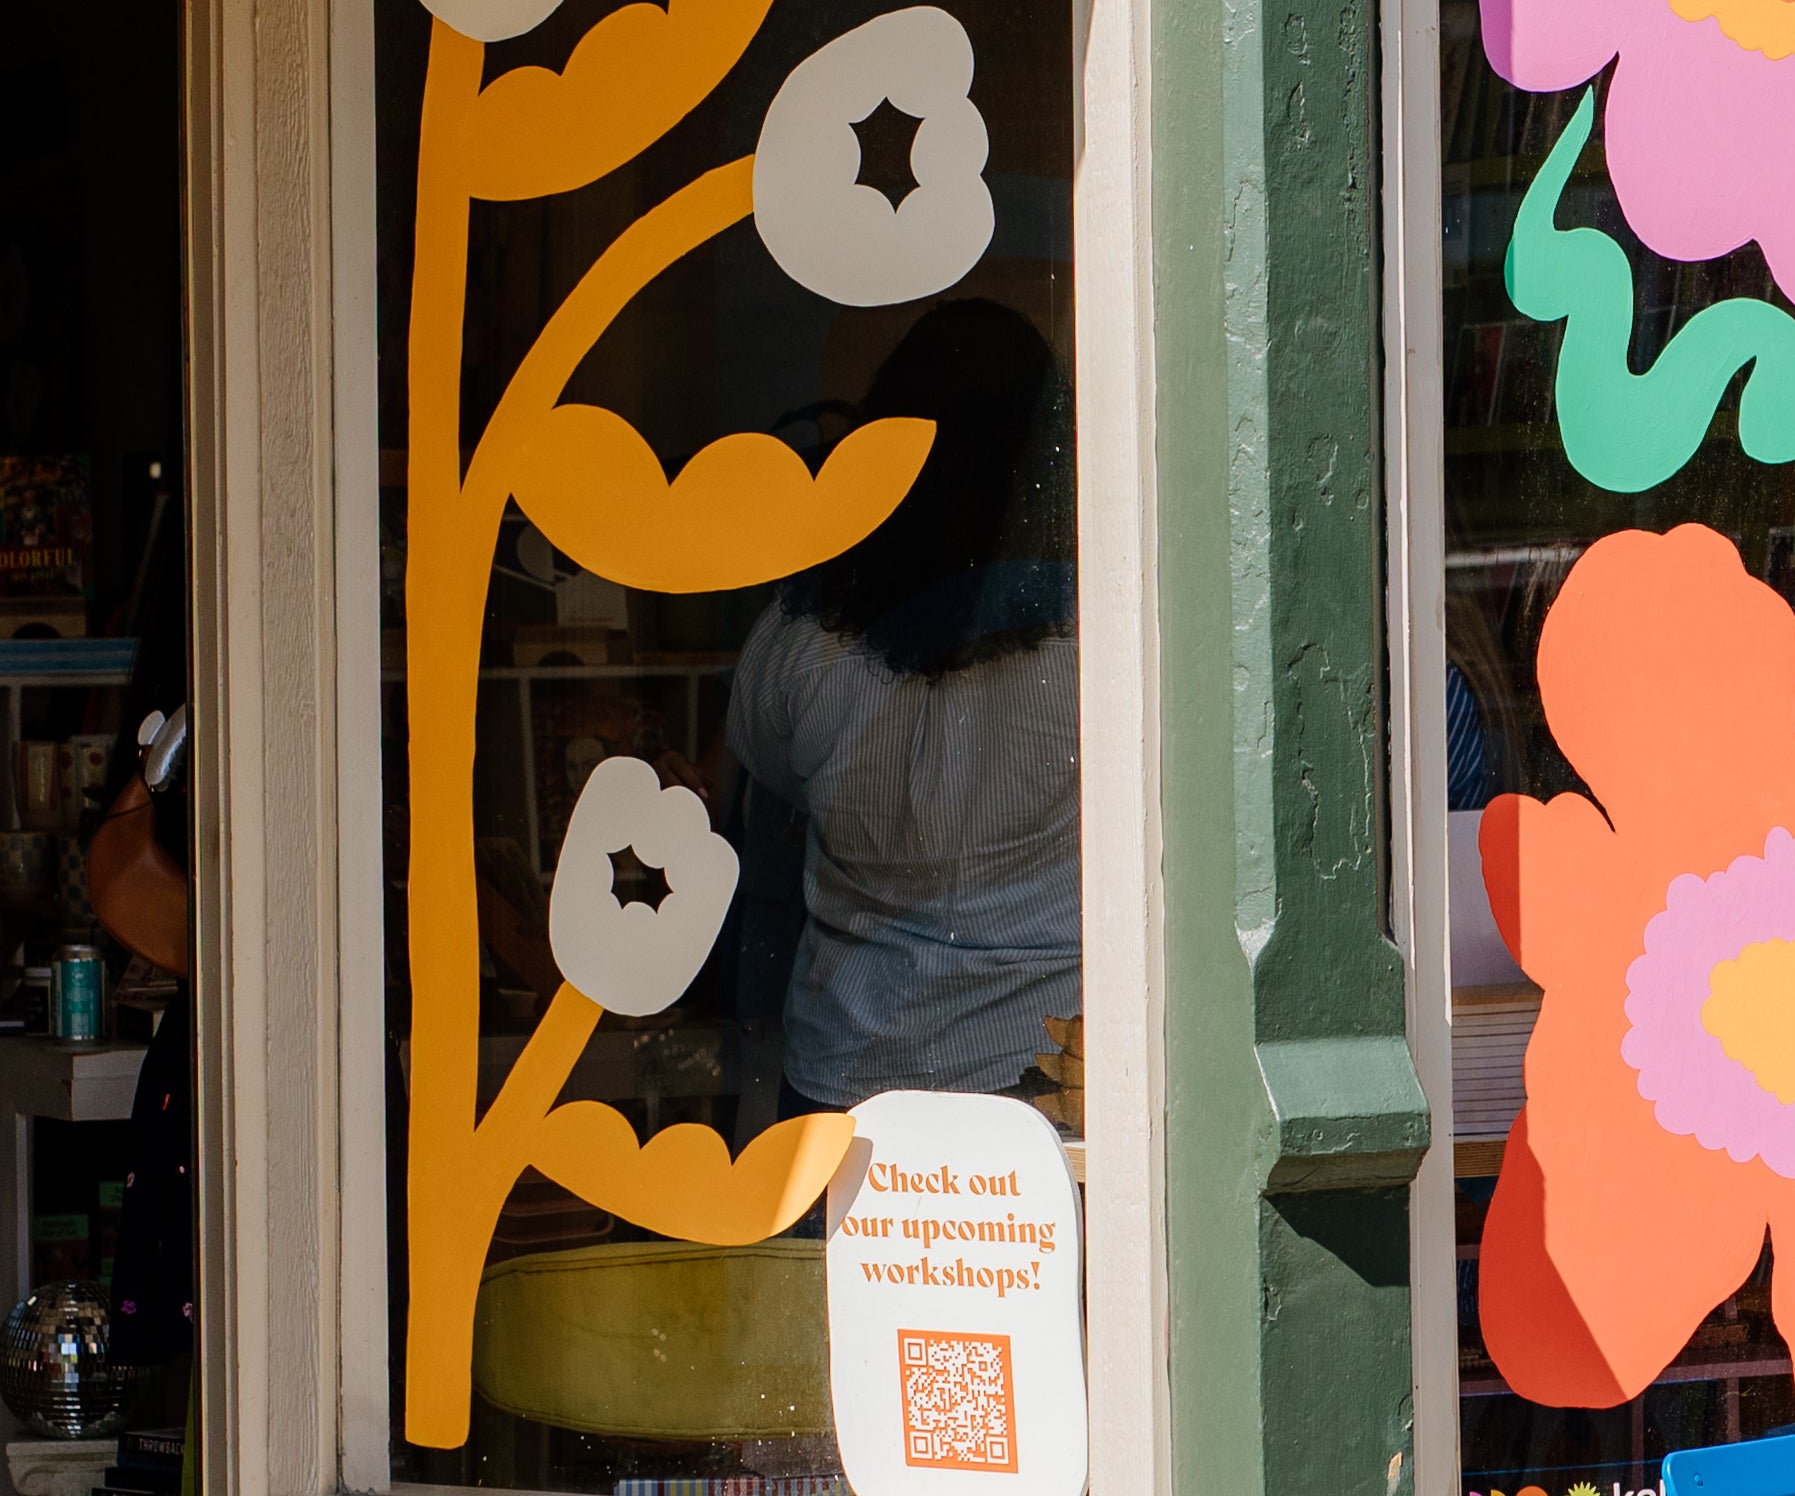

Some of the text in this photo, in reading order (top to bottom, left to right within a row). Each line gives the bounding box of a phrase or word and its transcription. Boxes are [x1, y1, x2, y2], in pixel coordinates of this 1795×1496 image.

[867, 1162, 1022, 1197] Check out
[841, 1212, 1056, 1254] our upcoming
[860, 1256, 1042, 1299] workshops!
